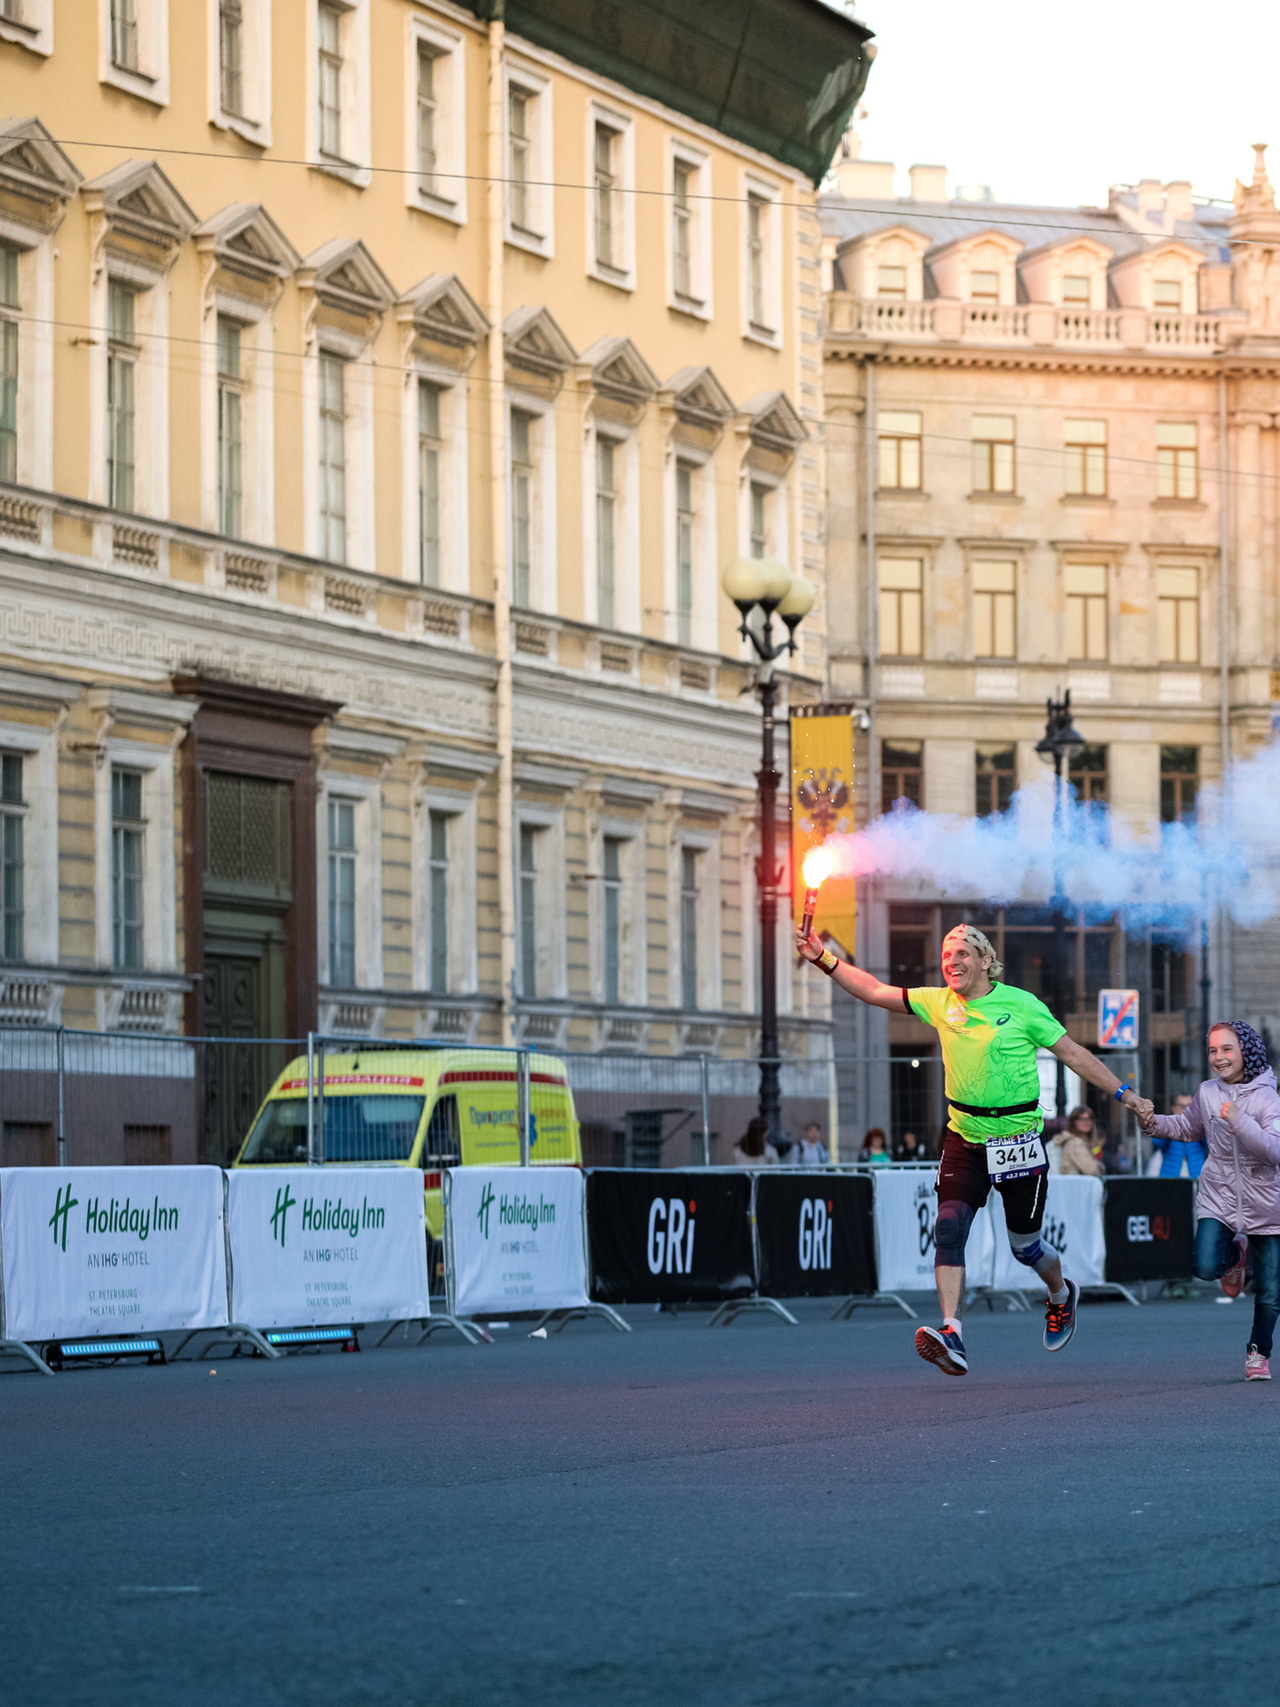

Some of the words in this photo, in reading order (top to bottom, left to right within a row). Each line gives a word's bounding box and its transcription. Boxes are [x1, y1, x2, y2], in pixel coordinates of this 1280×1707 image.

[996, 1143, 1038, 1165] 3414
[86, 1197, 151, 1240] Holiday
[153, 1195, 179, 1231] Inn
[302, 1197, 360, 1238] Holiday
[362, 1196, 385, 1229] Inn
[499, 1193, 539, 1232] Holiday
[540, 1193, 556, 1223] Inn
[1044, 1211, 1068, 1254] ite
[87, 1253, 100, 1268] AN
[122, 1252, 149, 1266] HOTEL
[303, 1249, 314, 1262] AN
[334, 1248, 359, 1261] HOTEL
[88, 1290, 97, 1301] ST.
[100, 1288, 138, 1300] PETERSBURG
[314, 1281, 348, 1292] PETERSBURG
[306, 1297, 329, 1308] THEATRE
[331, 1296, 352, 1308] SQUARE
[89, 1305, 116, 1317] THEATRE
[118, 1304, 141, 1316] SQUARE
